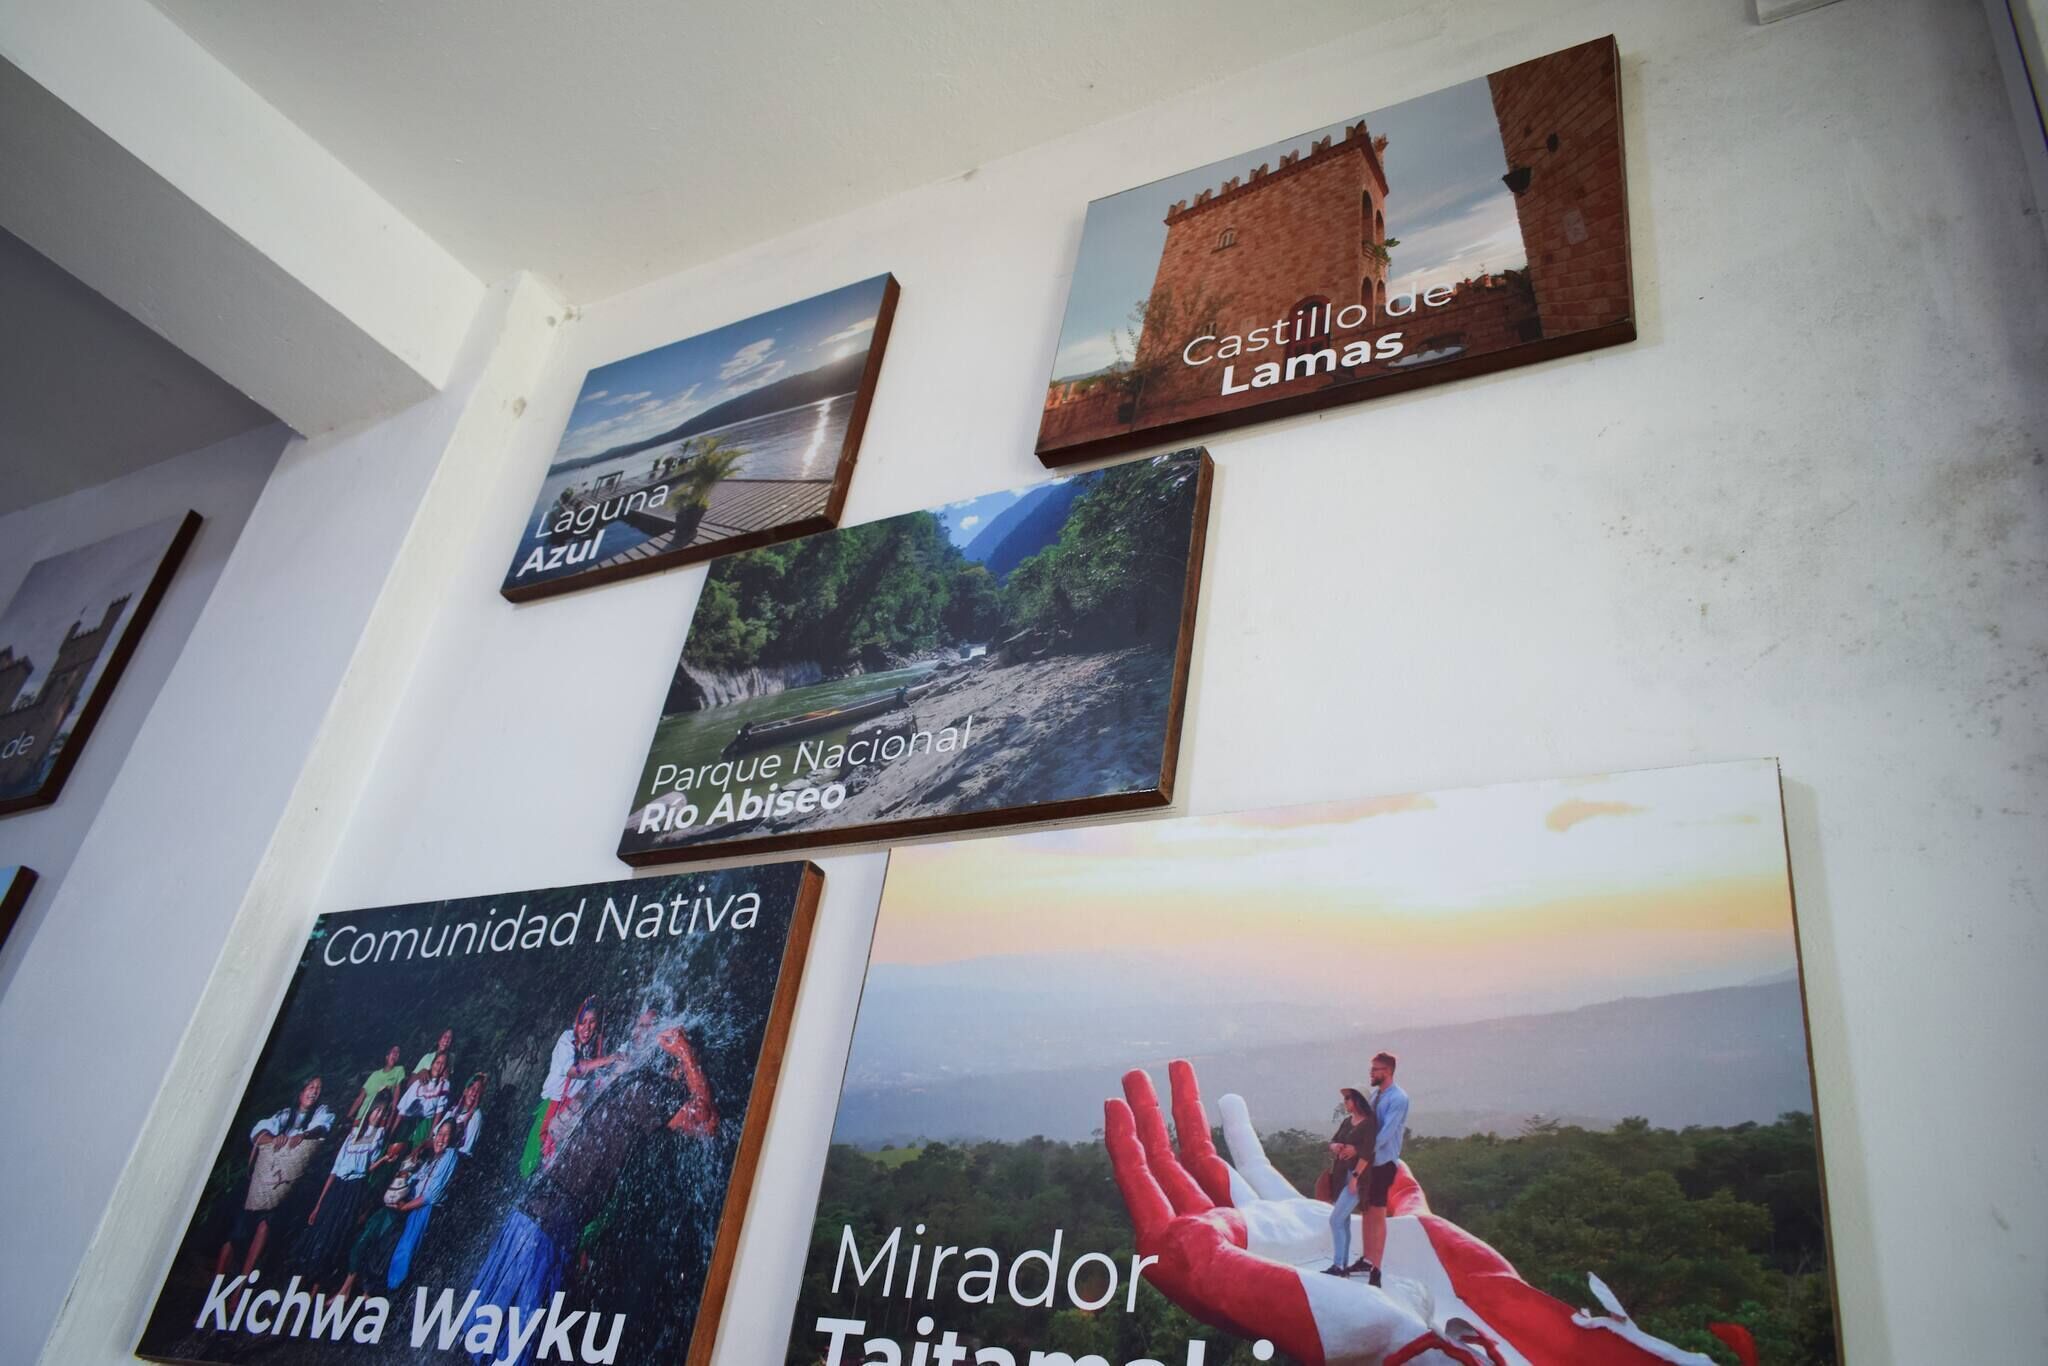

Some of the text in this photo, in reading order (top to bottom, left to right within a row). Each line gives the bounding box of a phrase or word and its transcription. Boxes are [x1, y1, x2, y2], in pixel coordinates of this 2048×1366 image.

[1182, 280, 1455, 367] Castillo de
[1220, 331, 1405, 397] Lamas
[534, 484, 670, 539] Laguna
[515, 528, 606, 578] Azul
[1, 730, 35, 759] de
[650, 714, 974, 795] Parque Nacional
[637, 782, 847, 835] Río Abiseo
[322, 885, 762, 968] Comunidad Nativa
[831, 1223, 1160, 1313] Mirador
[195, 1269, 627, 1366] Kichwa Wayku
